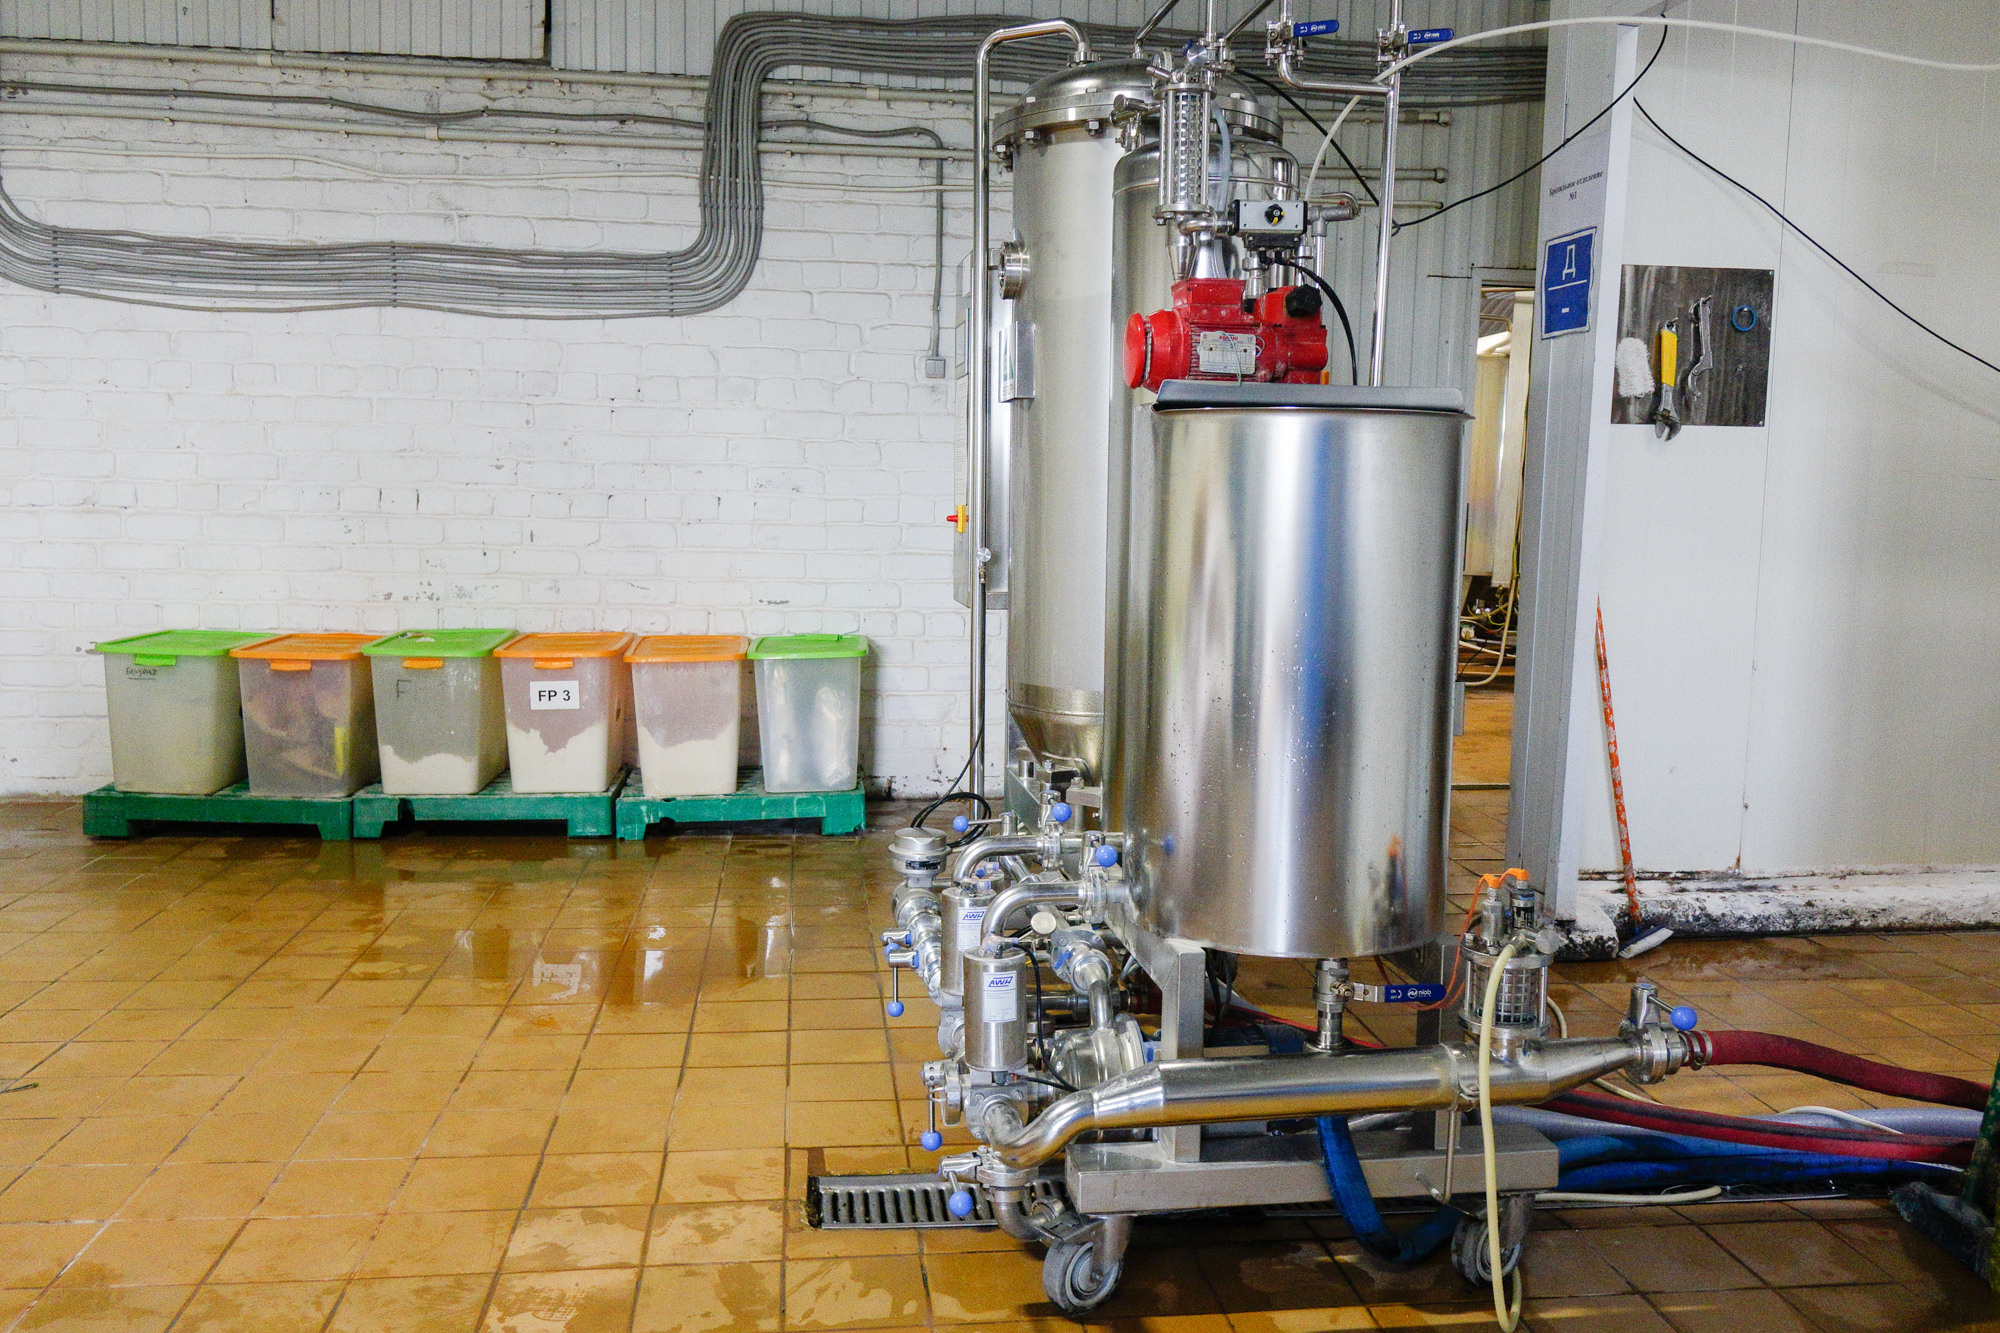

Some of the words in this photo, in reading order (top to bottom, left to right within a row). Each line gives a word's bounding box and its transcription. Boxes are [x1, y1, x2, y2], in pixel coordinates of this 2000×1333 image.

[1562, 244, 1576, 280] Д
[538, 690, 557, 702] FP
[562, 689, 571, 702] 3
[963, 911, 985, 921] AWH
[988, 976, 1013, 988] AWH
